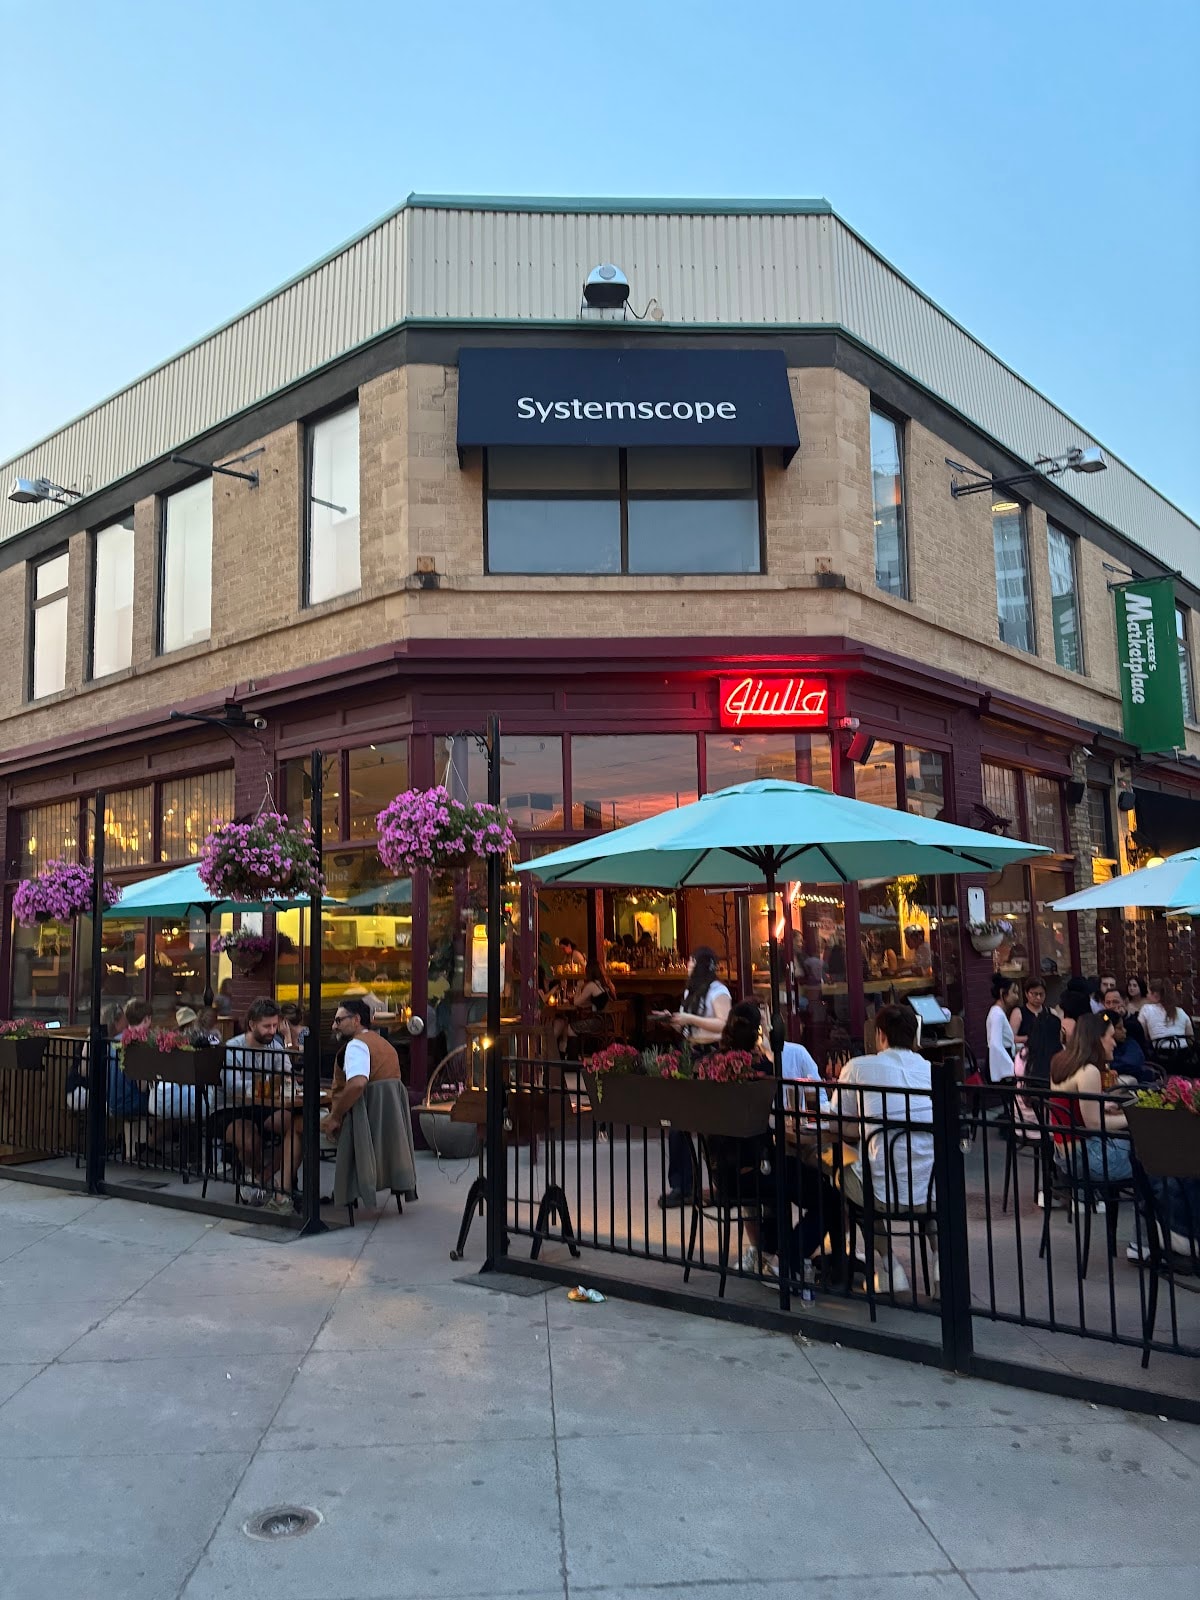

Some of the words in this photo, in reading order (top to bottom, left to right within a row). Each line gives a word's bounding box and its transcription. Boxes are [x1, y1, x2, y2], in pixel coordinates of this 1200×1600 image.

[516, 396, 737, 424] Systemscope
[1122, 591, 1153, 705] Marketplace
[1146, 621, 1158, 672] TUCKER'S
